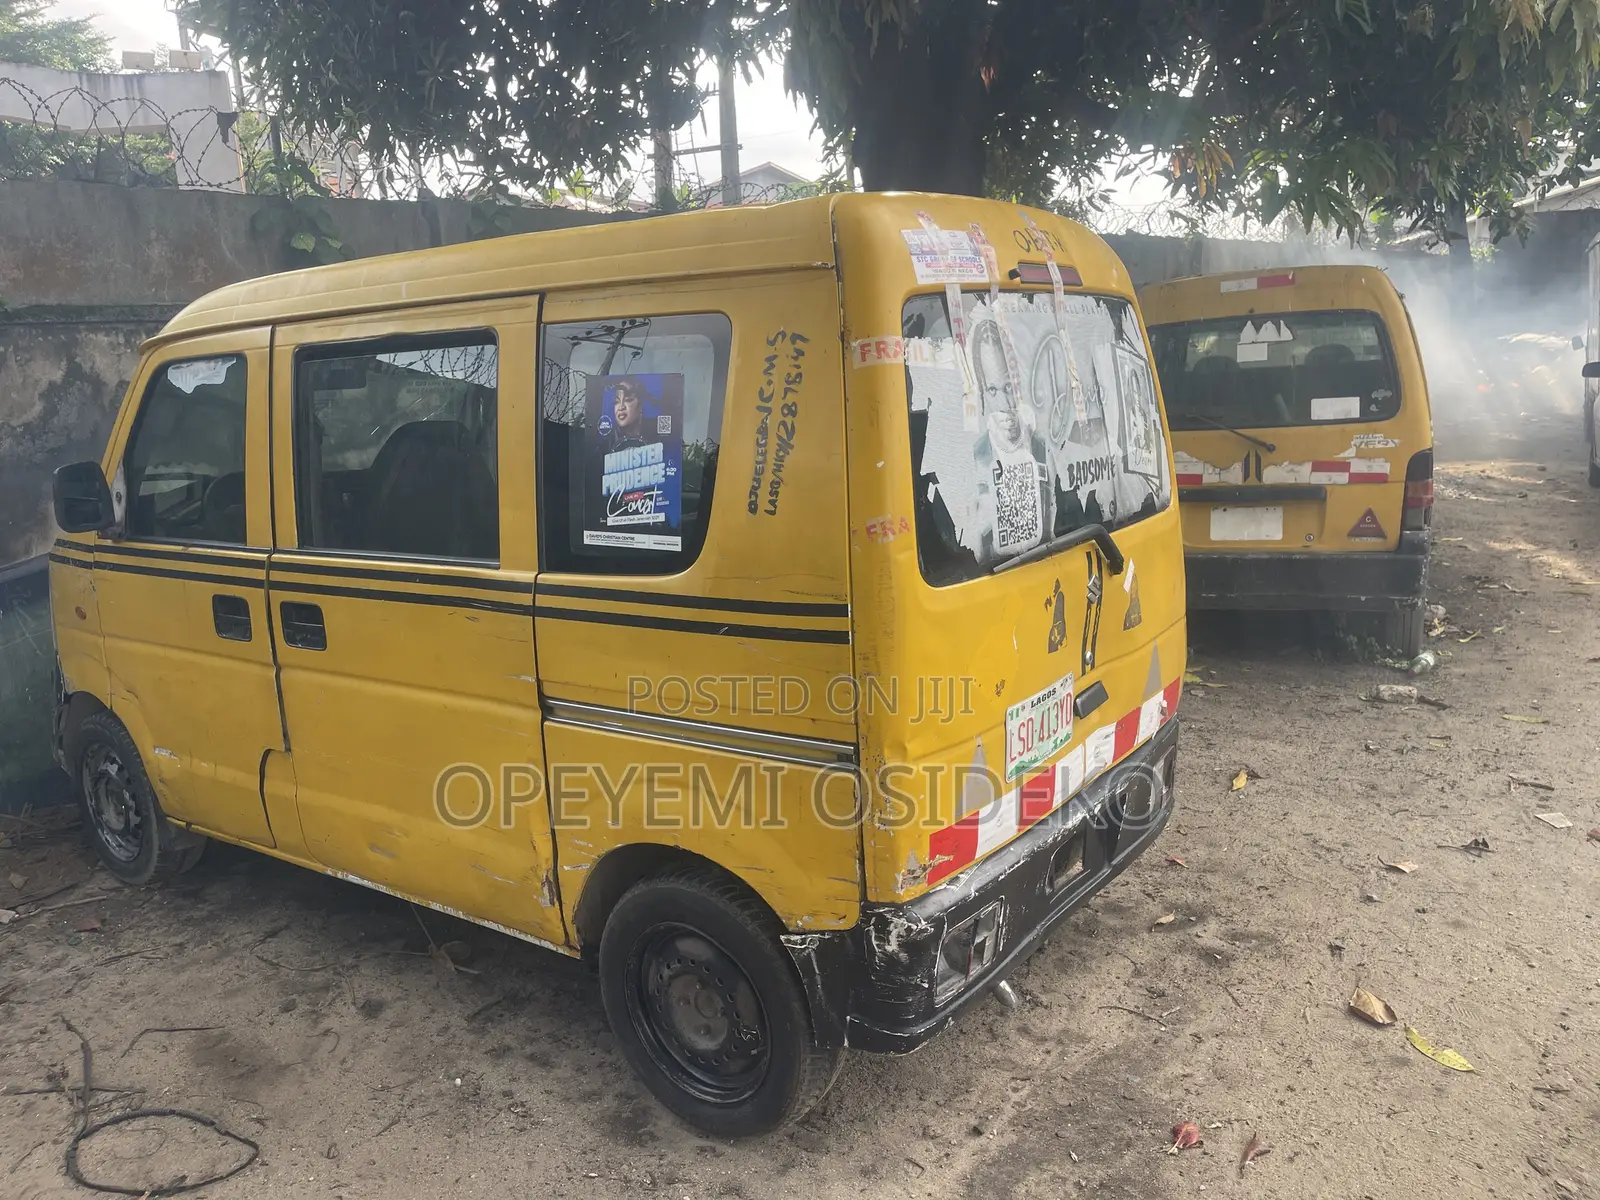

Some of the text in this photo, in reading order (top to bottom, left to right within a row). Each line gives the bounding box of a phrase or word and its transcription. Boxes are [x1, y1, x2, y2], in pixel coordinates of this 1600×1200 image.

[604, 442, 664, 474] MINISTER
[1067, 454, 1116, 488] BADSOME
[1030, 687, 1057, 709] LAGOS
